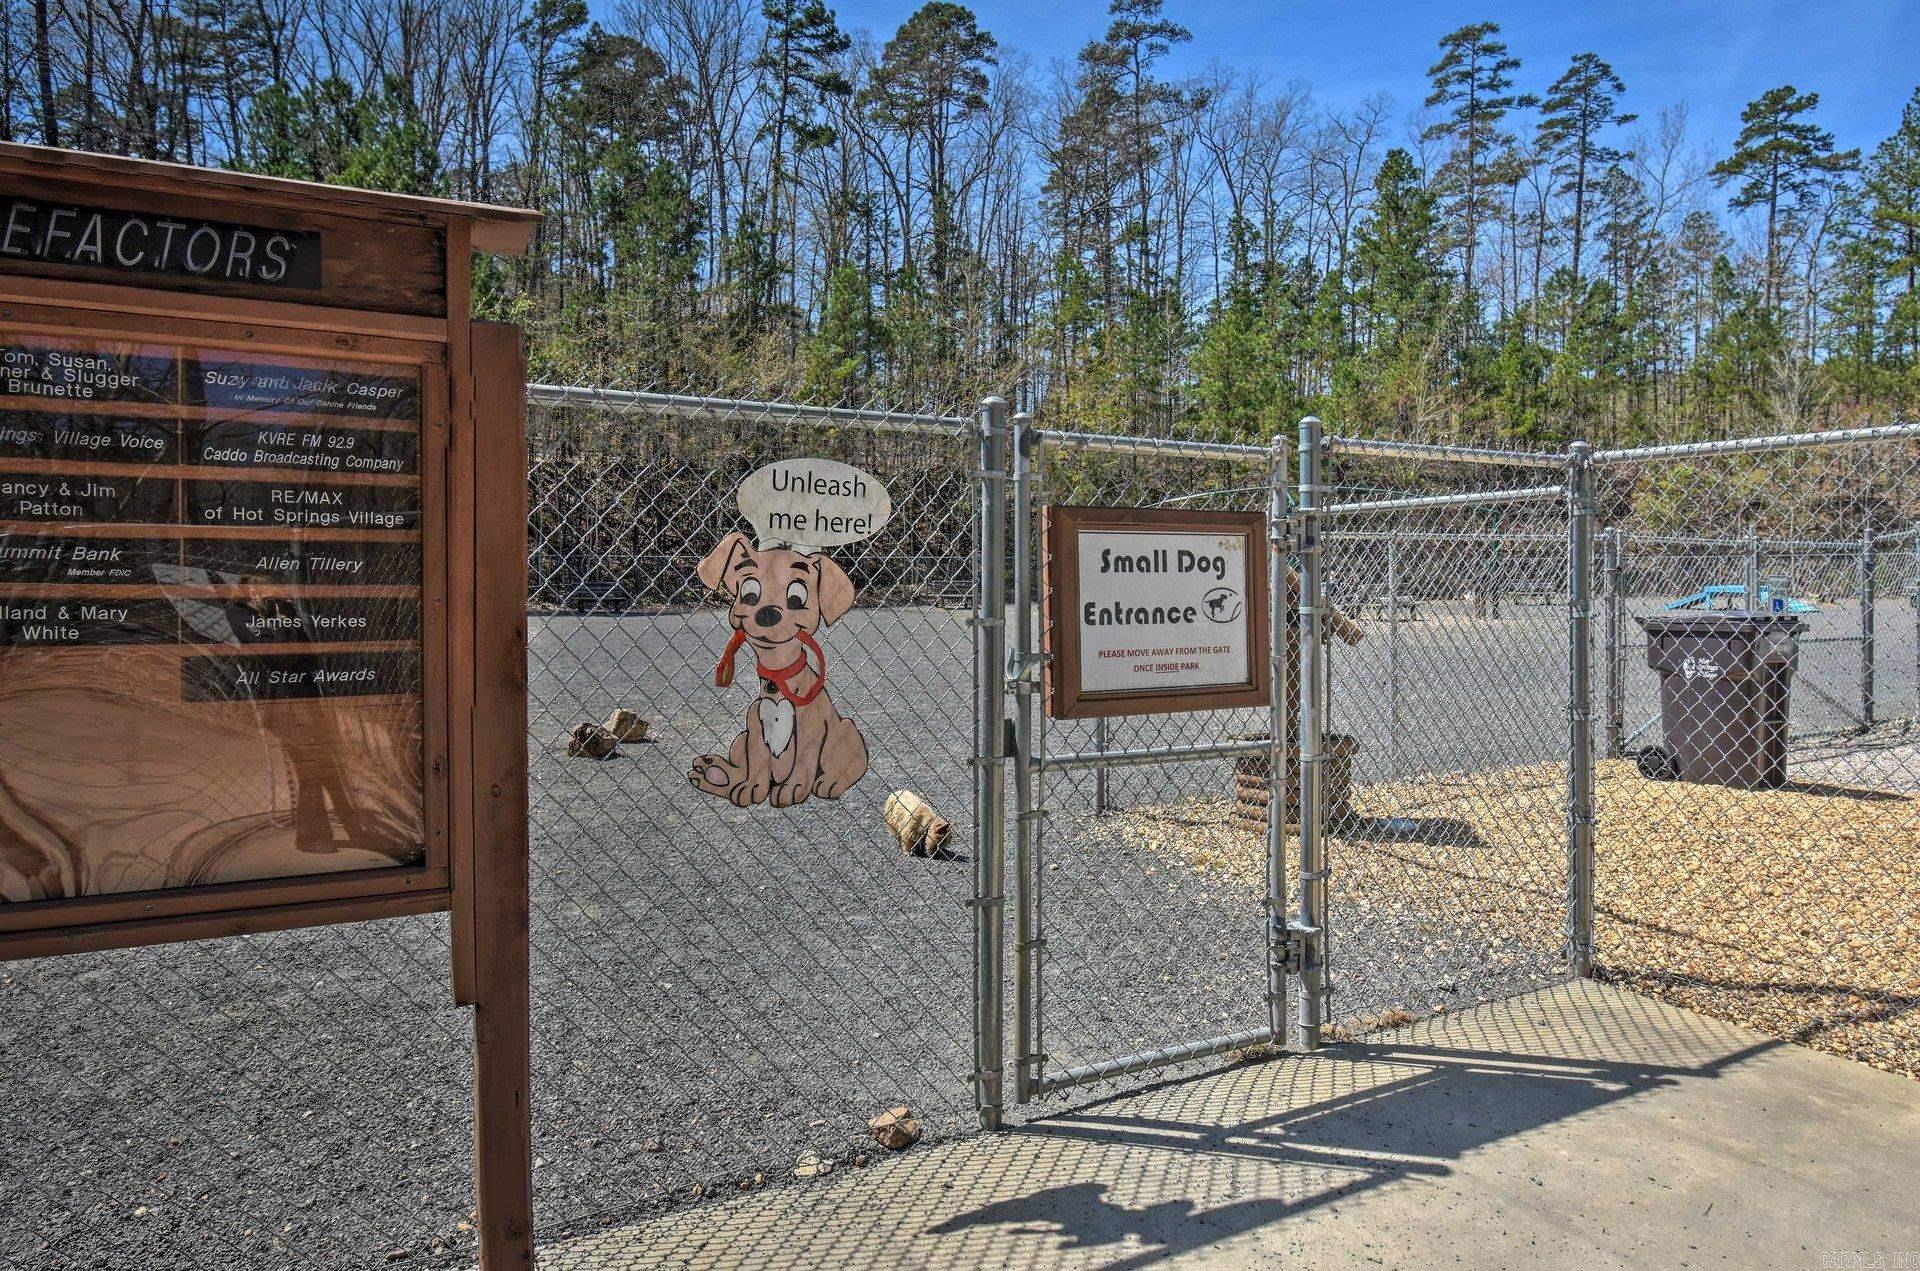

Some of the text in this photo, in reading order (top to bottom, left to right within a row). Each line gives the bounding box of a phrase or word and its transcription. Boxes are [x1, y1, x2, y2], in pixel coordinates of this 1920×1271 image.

[2, 202, 291, 281] EFACTORS
[0, 348, 112, 371] om, Susan,
[42, 366, 53, 381] &
[64, 369, 139, 389] Slugger
[205, 371, 404, 400] Suzy and Jack Casper
[8, 379, 94, 398] Brunette
[246, 395, 281, 404] Memory
[316, 400, 344, 409] Canine
[347, 402, 377, 411] Friends
[54, 430, 111, 450] Village
[121, 433, 164, 449] Voice
[257, 431, 355, 449] KVRE FM 92.9
[203, 447, 404, 473] Caddo Broadcasting Company
[1, 482, 116, 498] ancy & Jim
[772, 468, 867, 498] Unleash
[271, 490, 343, 505] RE/MAX
[20, 500, 83, 516] Patton
[204, 506, 404, 528] of Hot Springs Village
[769, 508, 872, 535] me here!
[72, 546, 122, 561] Bank
[67, 568, 132, 577] Member FDIC
[255, 556, 363, 573] Allen Tillery
[1100, 548, 1226, 581] Small Dog
[58, 606, 70, 620] &
[81, 606, 128, 622] Mary
[246, 614, 367, 629] James Yerkes
[1083, 601, 1197, 626] Entrance
[23, 625, 80, 640] White
[1098, 645, 1231, 659] PLEASE MOVE AWAY FROM THE GATE
[1133, 662, 1200, 673] ONCE INSIDE PARK
[236, 668, 376, 685] All Star Awards
